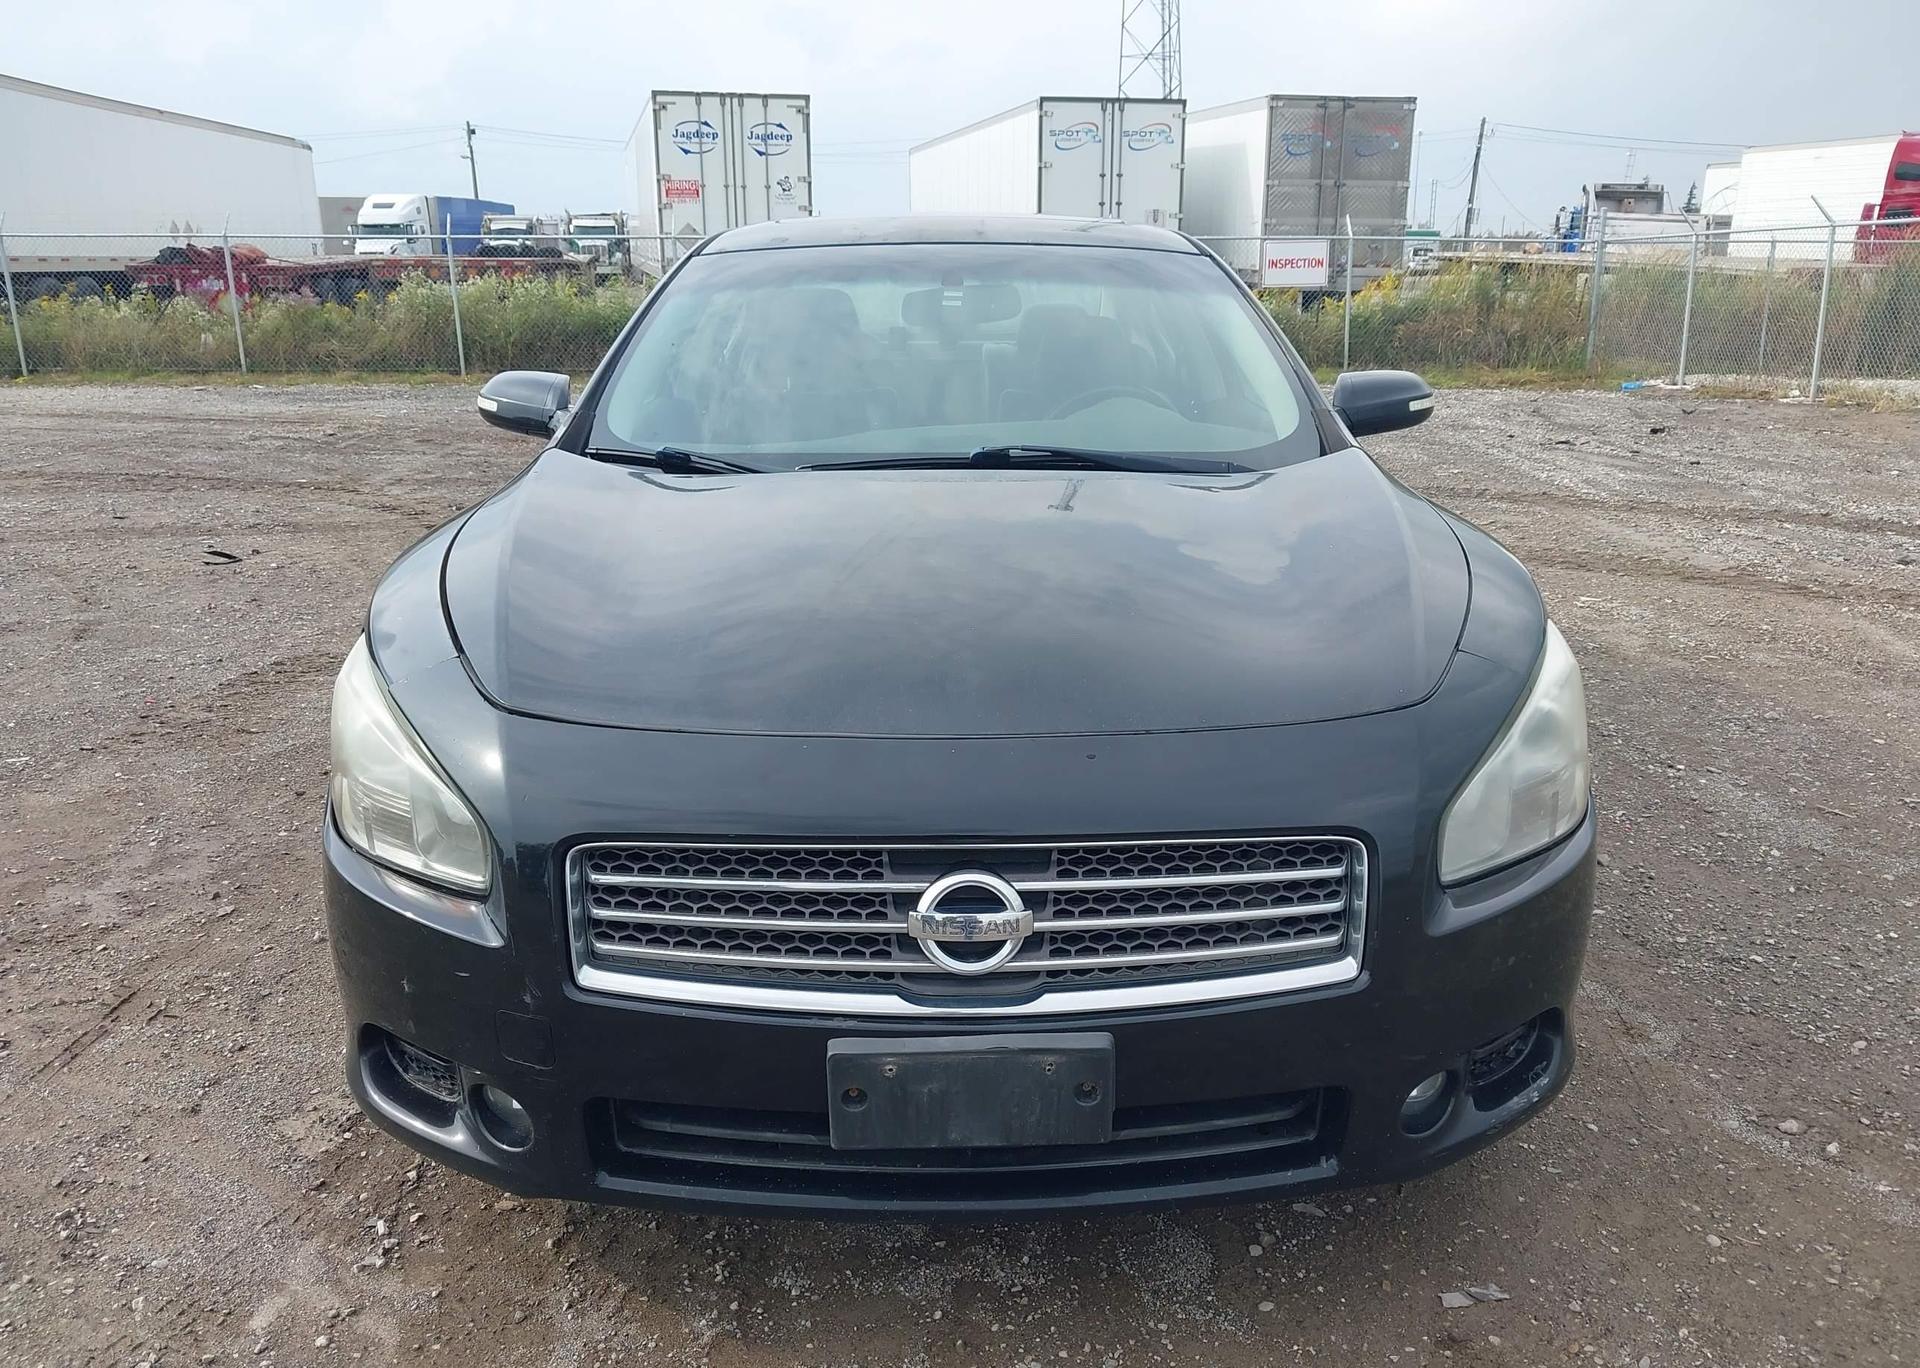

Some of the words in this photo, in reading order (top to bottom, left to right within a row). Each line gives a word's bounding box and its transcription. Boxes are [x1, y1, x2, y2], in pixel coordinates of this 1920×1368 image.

[672, 129, 719, 141] Jagdeep
[747, 130, 793, 142] Jagdeep
[1268, 257, 1324, 270] INSPECTION
[921, 917, 1020, 936] NISSAN
